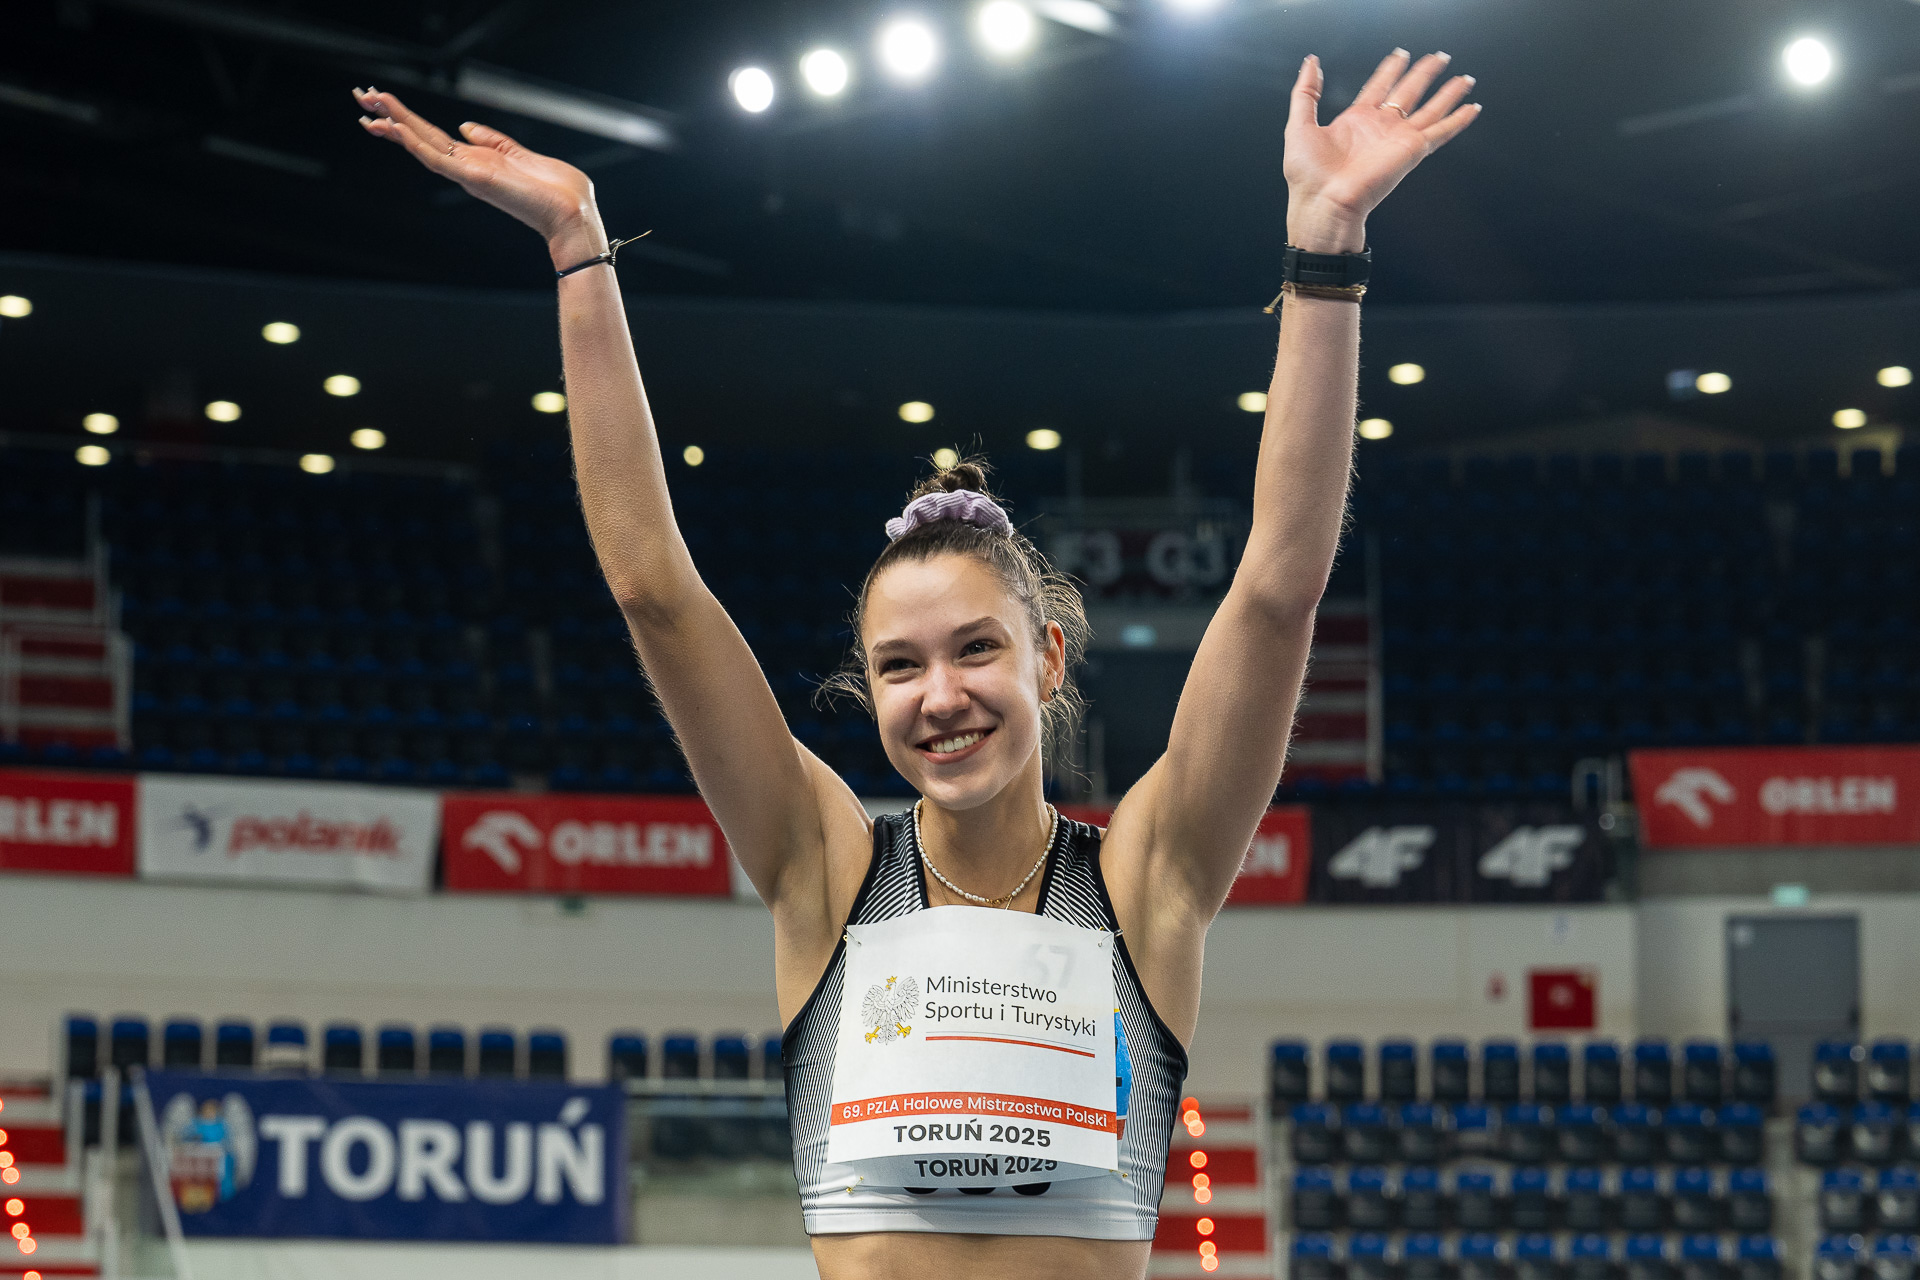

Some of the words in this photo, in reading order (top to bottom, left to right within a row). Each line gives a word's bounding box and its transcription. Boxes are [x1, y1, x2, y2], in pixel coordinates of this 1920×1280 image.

[1759, 775, 1896, 815] ORLEN
[228, 811, 401, 858] polanik
[551, 820, 713, 868] ORLEN
[1329, 825, 1436, 887] 4F
[1478, 825, 1584, 887] 4F
[926, 976, 1057, 1003] Ministerstwo
[925, 1001, 993, 1022] Sportu
[1000, 1003, 1005, 1021] i
[1011, 1005, 1096, 1036] Turystyki
[843, 1104, 863, 1119] 69.
[867, 1099, 899, 1115] PZLA
[903, 1096, 963, 1111] Halowe
[967, 1096, 1062, 1118] Mistrzostwa
[1066, 1108, 1107, 1127] Polski
[259, 1097, 604, 1204] TORUŃ
[894, 1118, 982, 1142] TORUŃ
[989, 1124, 1051, 1147] 2025
[914, 1154, 998, 1177] TORUŃ
[1004, 1156, 1057, 1175] 2025
